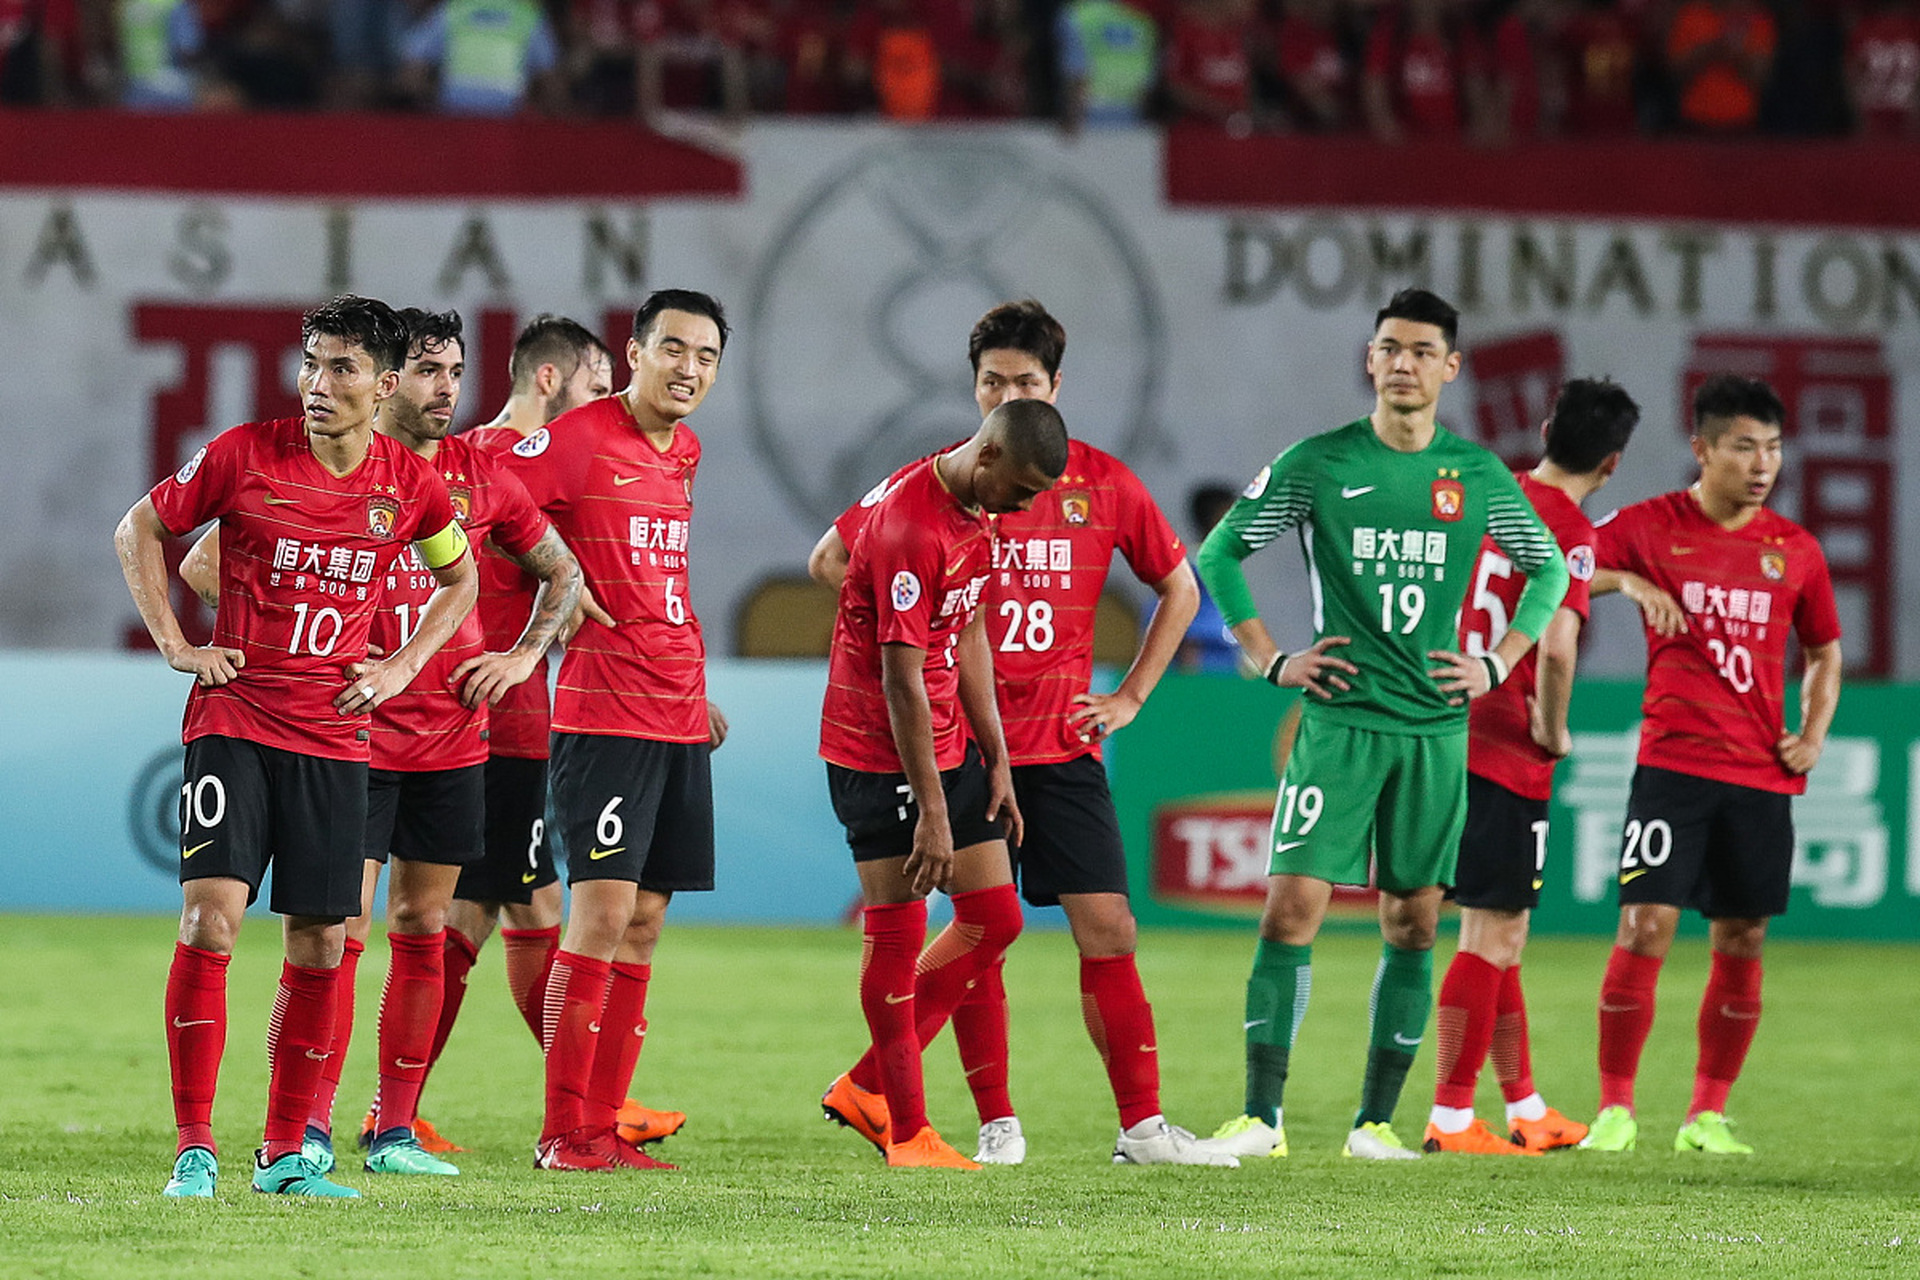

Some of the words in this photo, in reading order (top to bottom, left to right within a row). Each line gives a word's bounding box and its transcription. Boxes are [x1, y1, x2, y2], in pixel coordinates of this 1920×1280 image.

[26, 203, 648, 290] ASIAN
[1224, 213, 1920, 325] DOMINATION
[272, 537, 377, 583] 恒大集团
[1352, 527, 1447, 564] 恒大集团
[665, 577, 685, 625] 6
[999, 599, 1055, 652] 28
[1378, 583, 1426, 635] 19
[1455, 549, 1513, 658] 5
[1682, 581, 1772, 624] 恒大集团
[289, 603, 343, 656] 10
[182, 774, 226, 834] 10
[596, 796, 624, 846] 6
[1281, 785, 1324, 836] 19
[1621, 818, 1672, 869] 20
